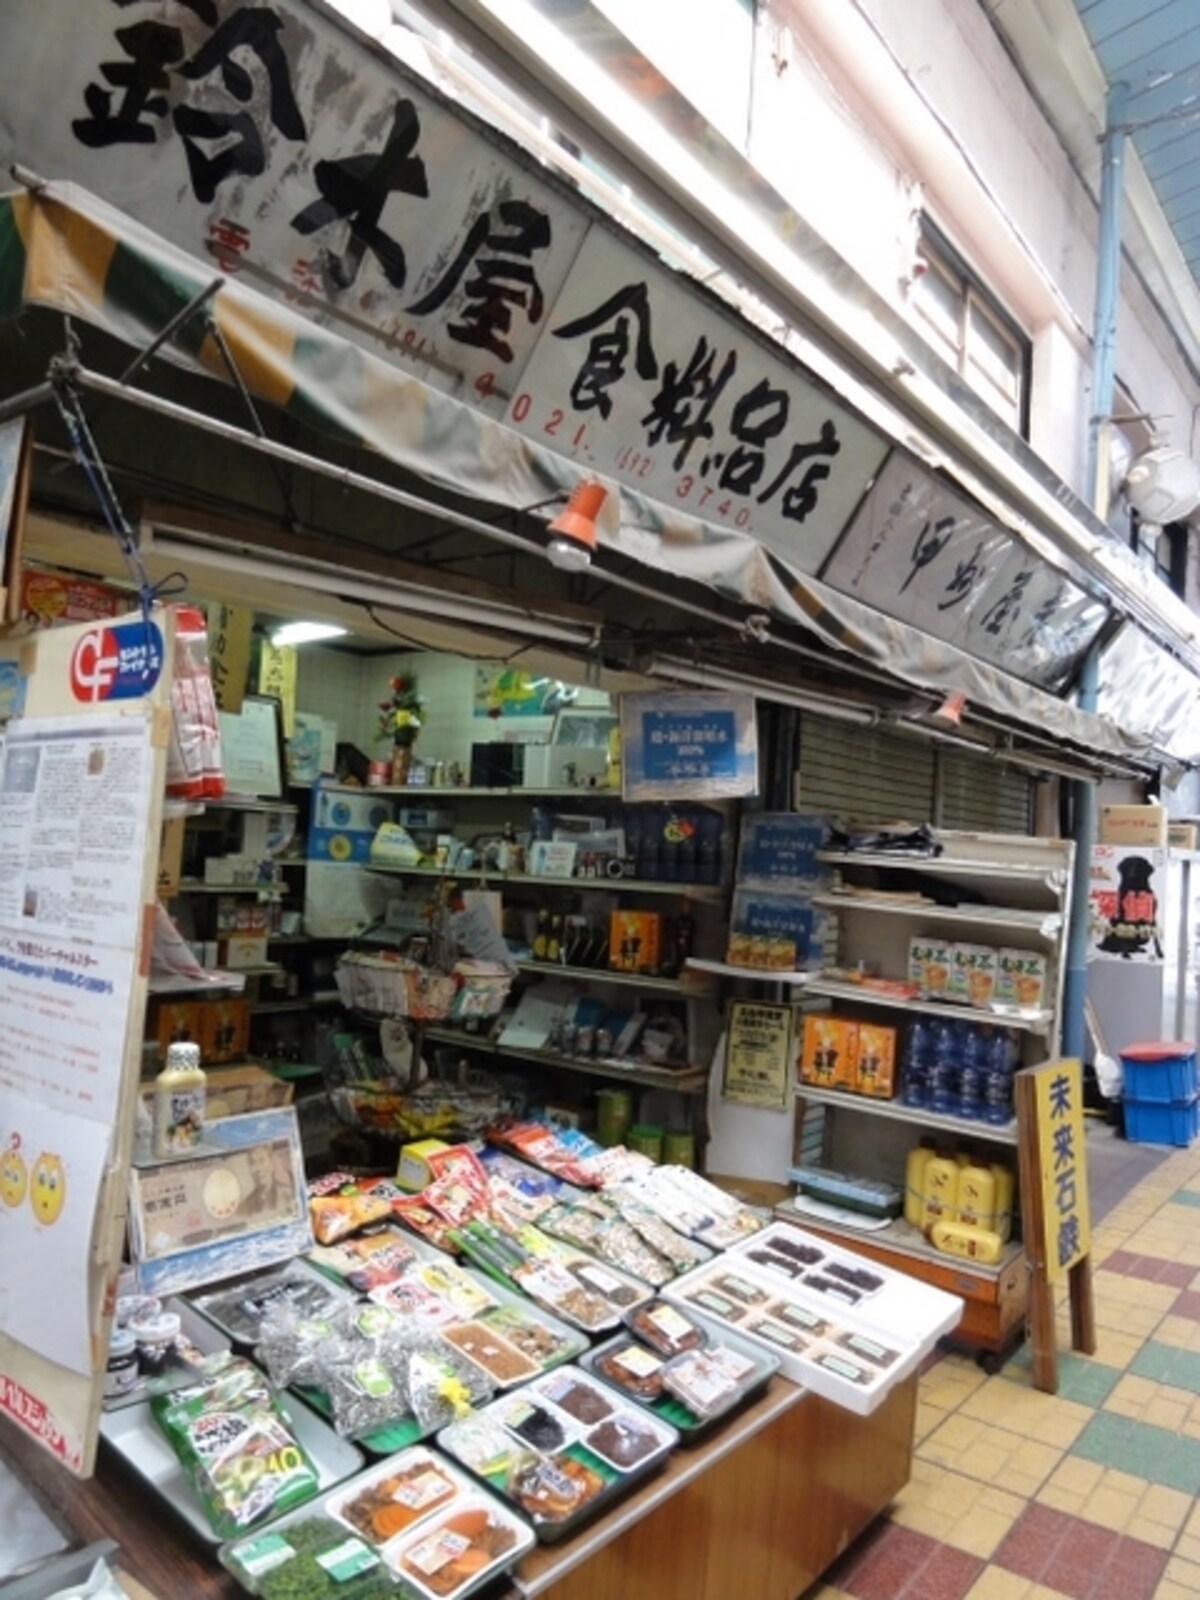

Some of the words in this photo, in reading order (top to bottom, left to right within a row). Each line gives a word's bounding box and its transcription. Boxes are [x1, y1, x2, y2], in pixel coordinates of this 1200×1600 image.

[72, 0, 550, 363] 鈴木屋
[553, 281, 841, 523] 食料品店
